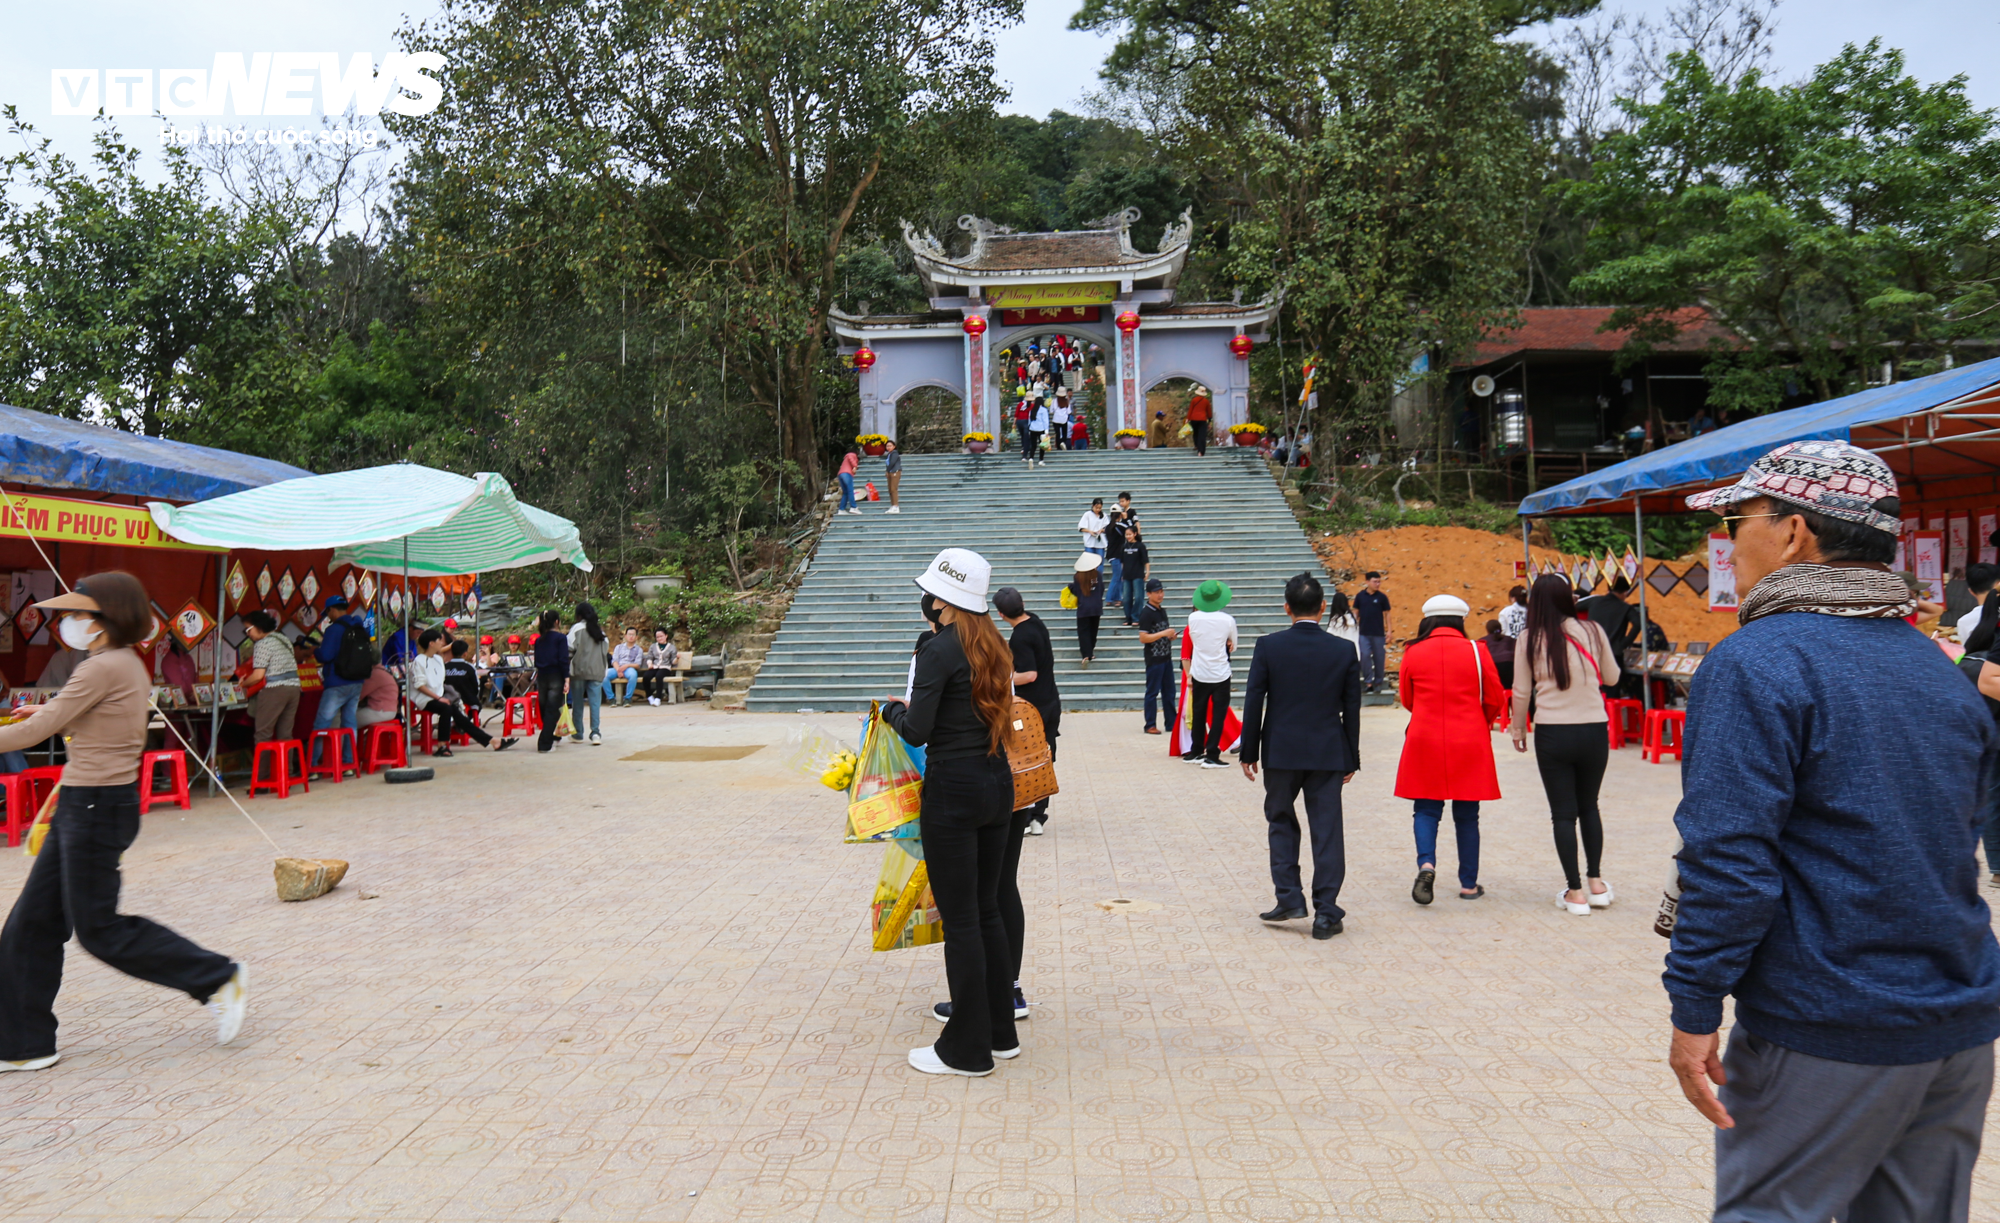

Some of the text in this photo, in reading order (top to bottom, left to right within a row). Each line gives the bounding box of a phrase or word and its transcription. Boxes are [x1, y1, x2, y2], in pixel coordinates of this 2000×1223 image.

[57, 511, 117, 541] PHỤC
[125, 518, 150, 545] VỤ
[938, 561, 967, 583] Gucci
